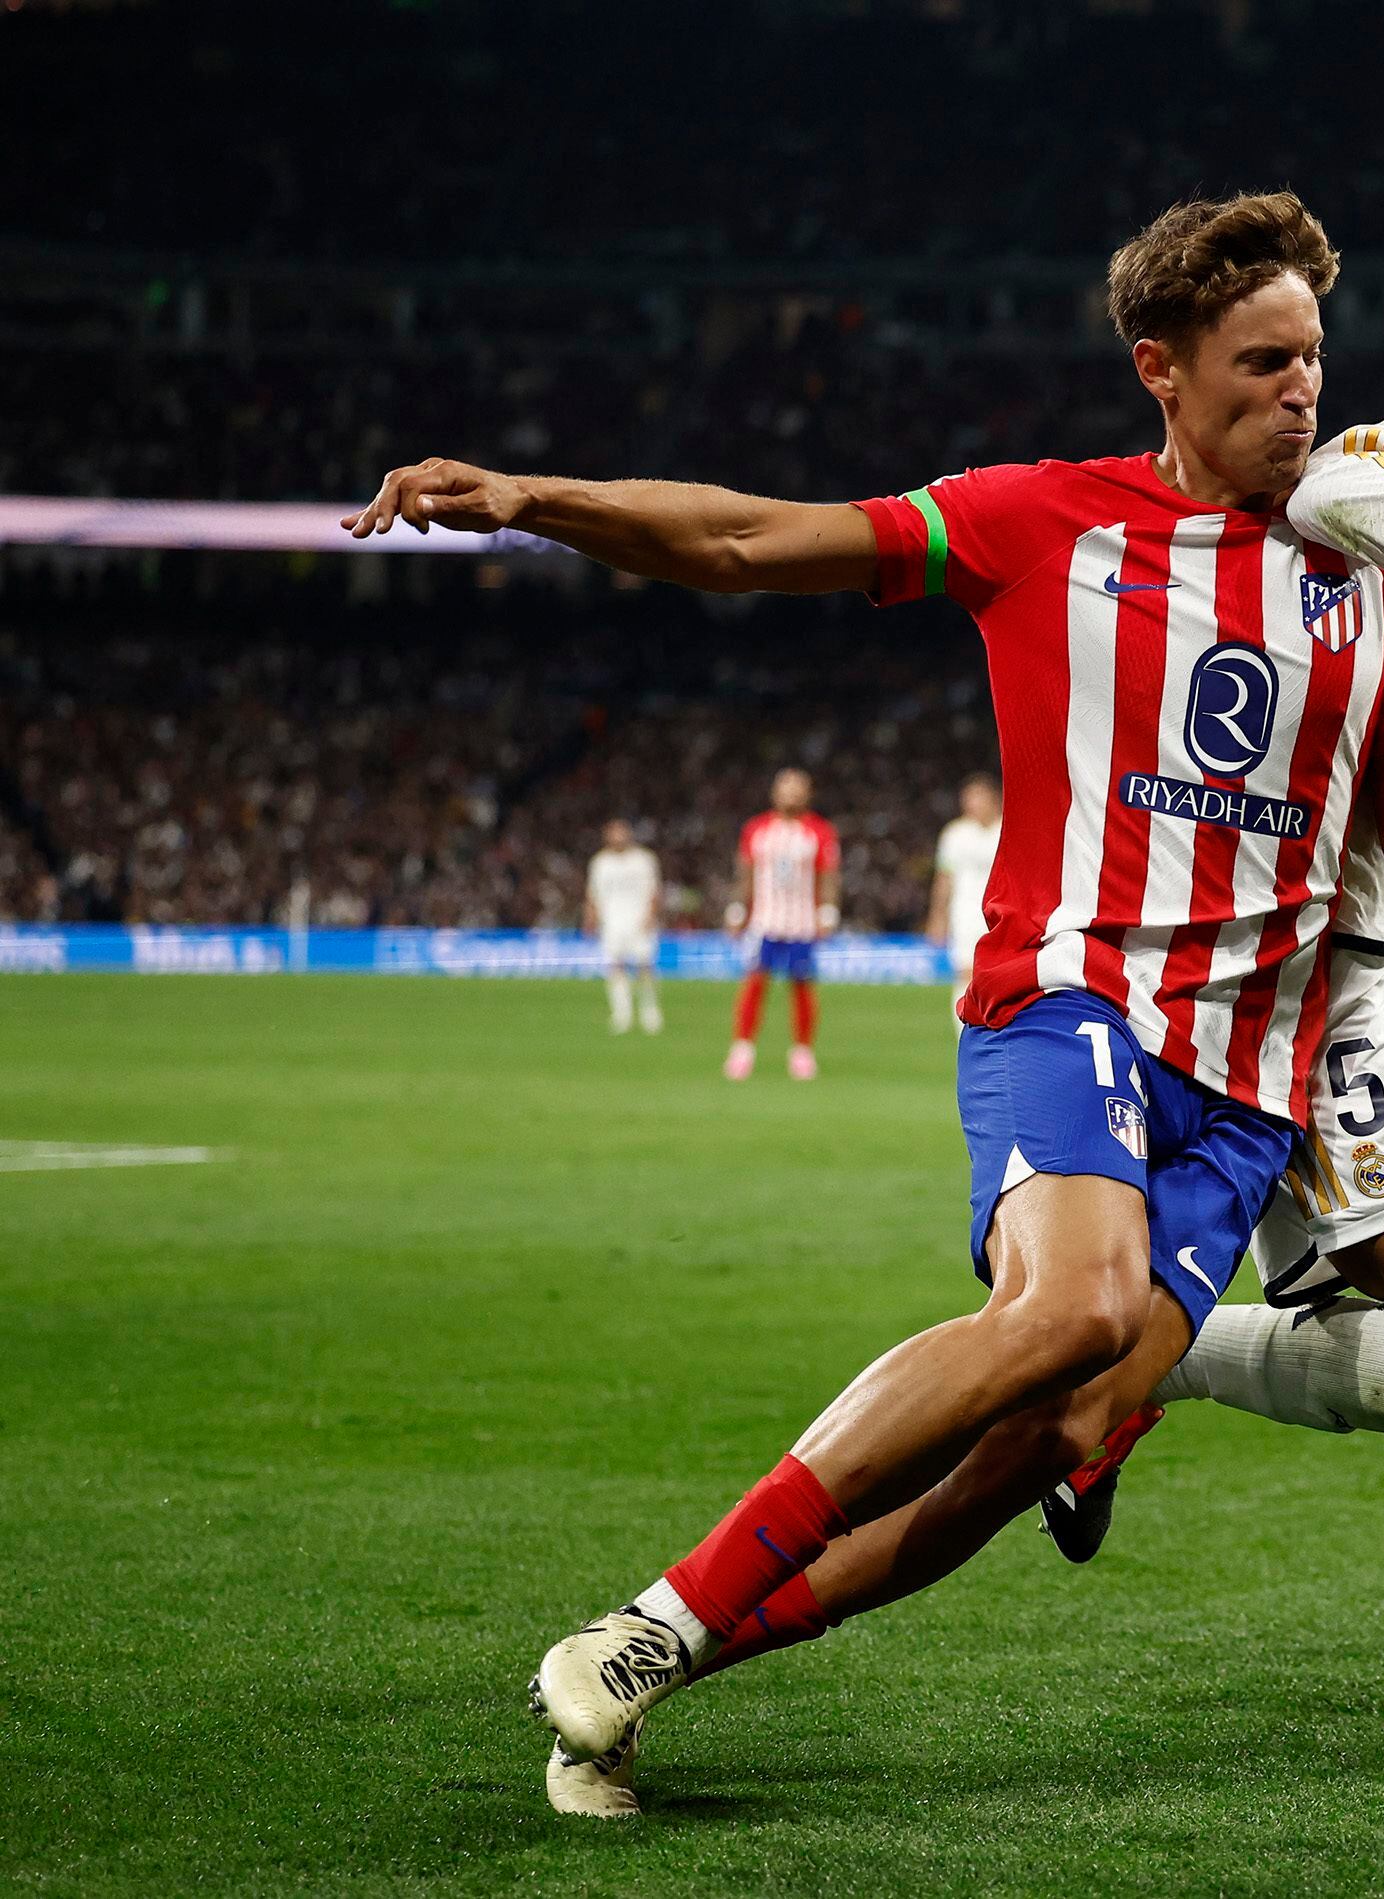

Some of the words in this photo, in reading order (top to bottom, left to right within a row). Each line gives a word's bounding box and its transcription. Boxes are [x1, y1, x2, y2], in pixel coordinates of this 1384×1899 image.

[1127, 775, 1247, 826] RIYADH
[1253, 802, 1304, 836] AIR
[1075, 1020, 1149, 1107] 1
